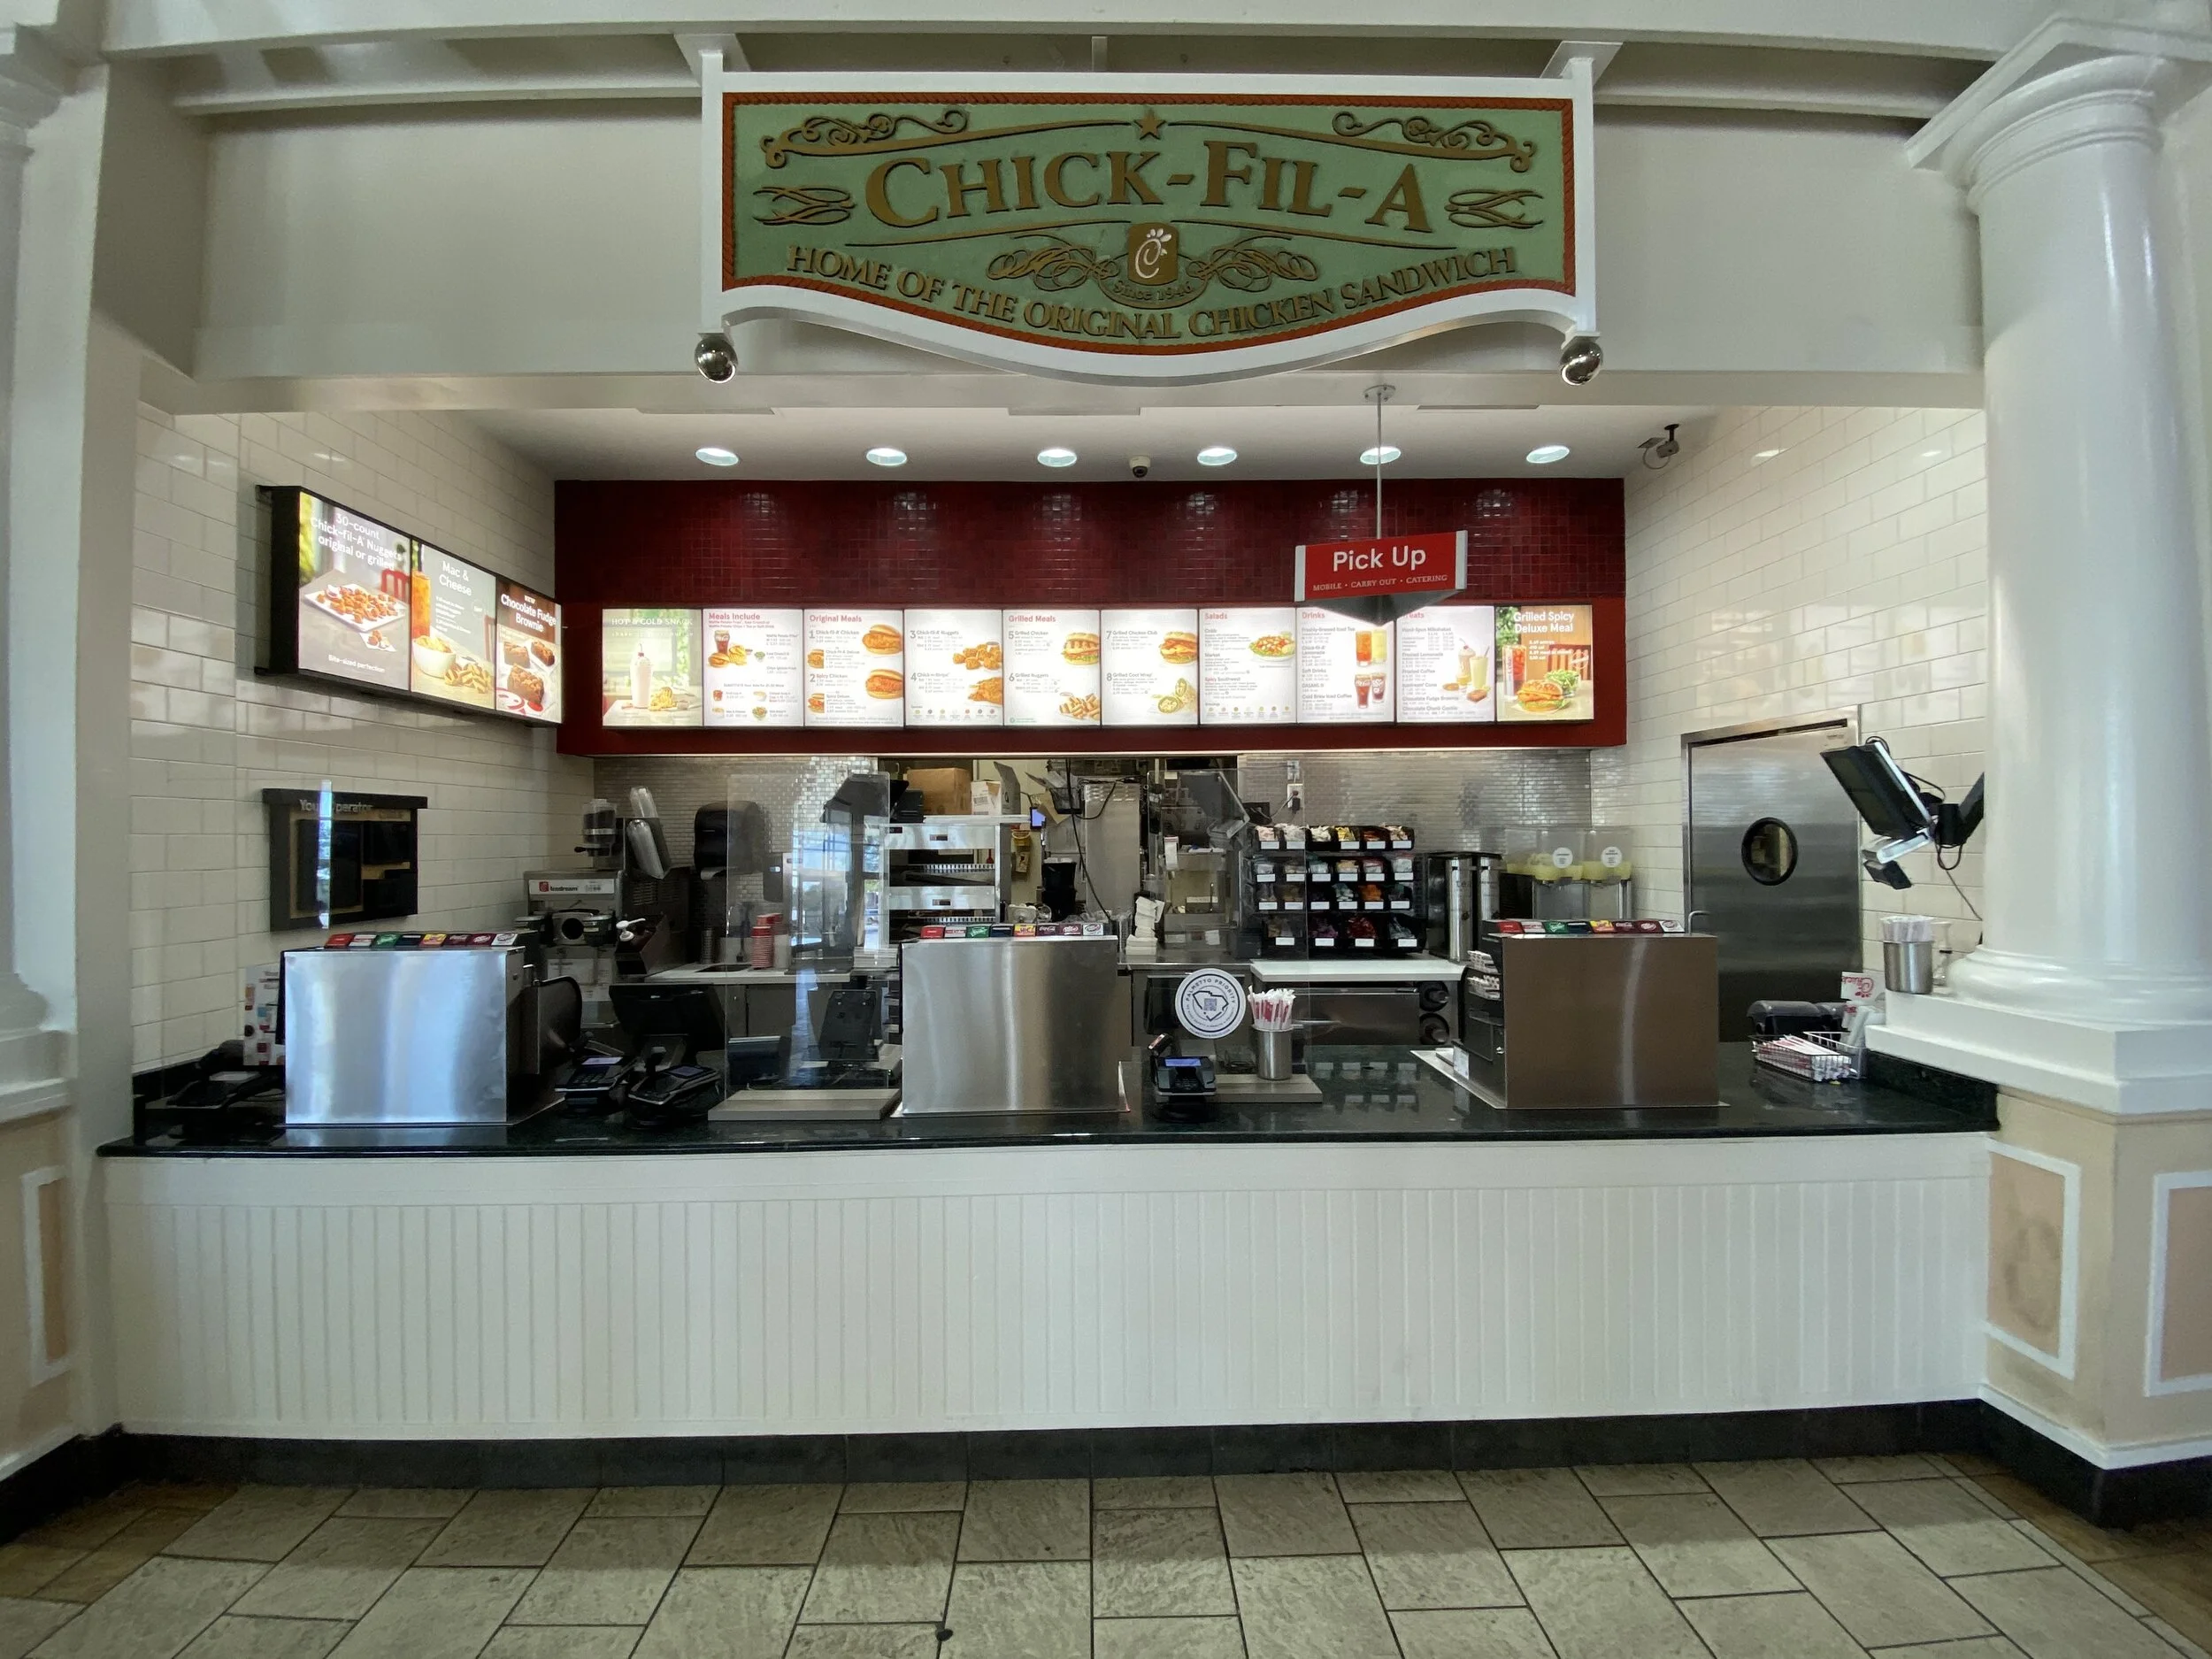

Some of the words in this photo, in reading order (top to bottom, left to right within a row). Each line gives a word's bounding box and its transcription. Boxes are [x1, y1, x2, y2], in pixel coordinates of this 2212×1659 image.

[787, 244, 891, 290] HOME
[896, 269, 944, 303] OF
[951, 282, 1019, 324] THE
[1023, 299, 1181, 340] ORIGINAL
[1187, 288, 1337, 338] CHICKEN
[1340, 246, 1517, 311] SANDWICH
[1114, 280, 1153, 301] Since
[1156, 280, 1194, 301] 1946
[335, 513, 380, 539] 30-count
[356, 549, 365, 559] or
[1333, 547, 1383, 572] Pick
[1392, 545, 1426, 571] Up
[442, 560, 461, 578] Mac
[463, 570, 470, 582] &
[439, 573, 472, 596] Cheese
[1312, 582, 1342, 592] MOBILE
[1350, 580, 1378, 588] CARRY
[1379, 578, 1396, 587] OUT
[1406, 574, 1448, 584] CATERING
[501, 593, 537, 618] Chocolate
[537, 607, 557, 626] Fudge
[516, 611, 544, 633] Brownie
[1514, 612, 1546, 621] Grilled
[1548, 612, 1574, 622] Spicy
[809, 630, 815, 639] 1
[910, 630, 916, 639] 3
[1515, 624, 1548, 633] Deluxe
[1551, 623, 1573, 632] Meal
[1008, 631, 1014, 640] 5
[810, 673, 816, 682] 2
[910, 672, 917, 681] 4
[1009, 672, 1015, 681] 6
[1106, 672, 1112, 681] 8
[1185, 978, 1212, 1002] PALMETTO
[1214, 979, 1236, 1003] PRIORITY
